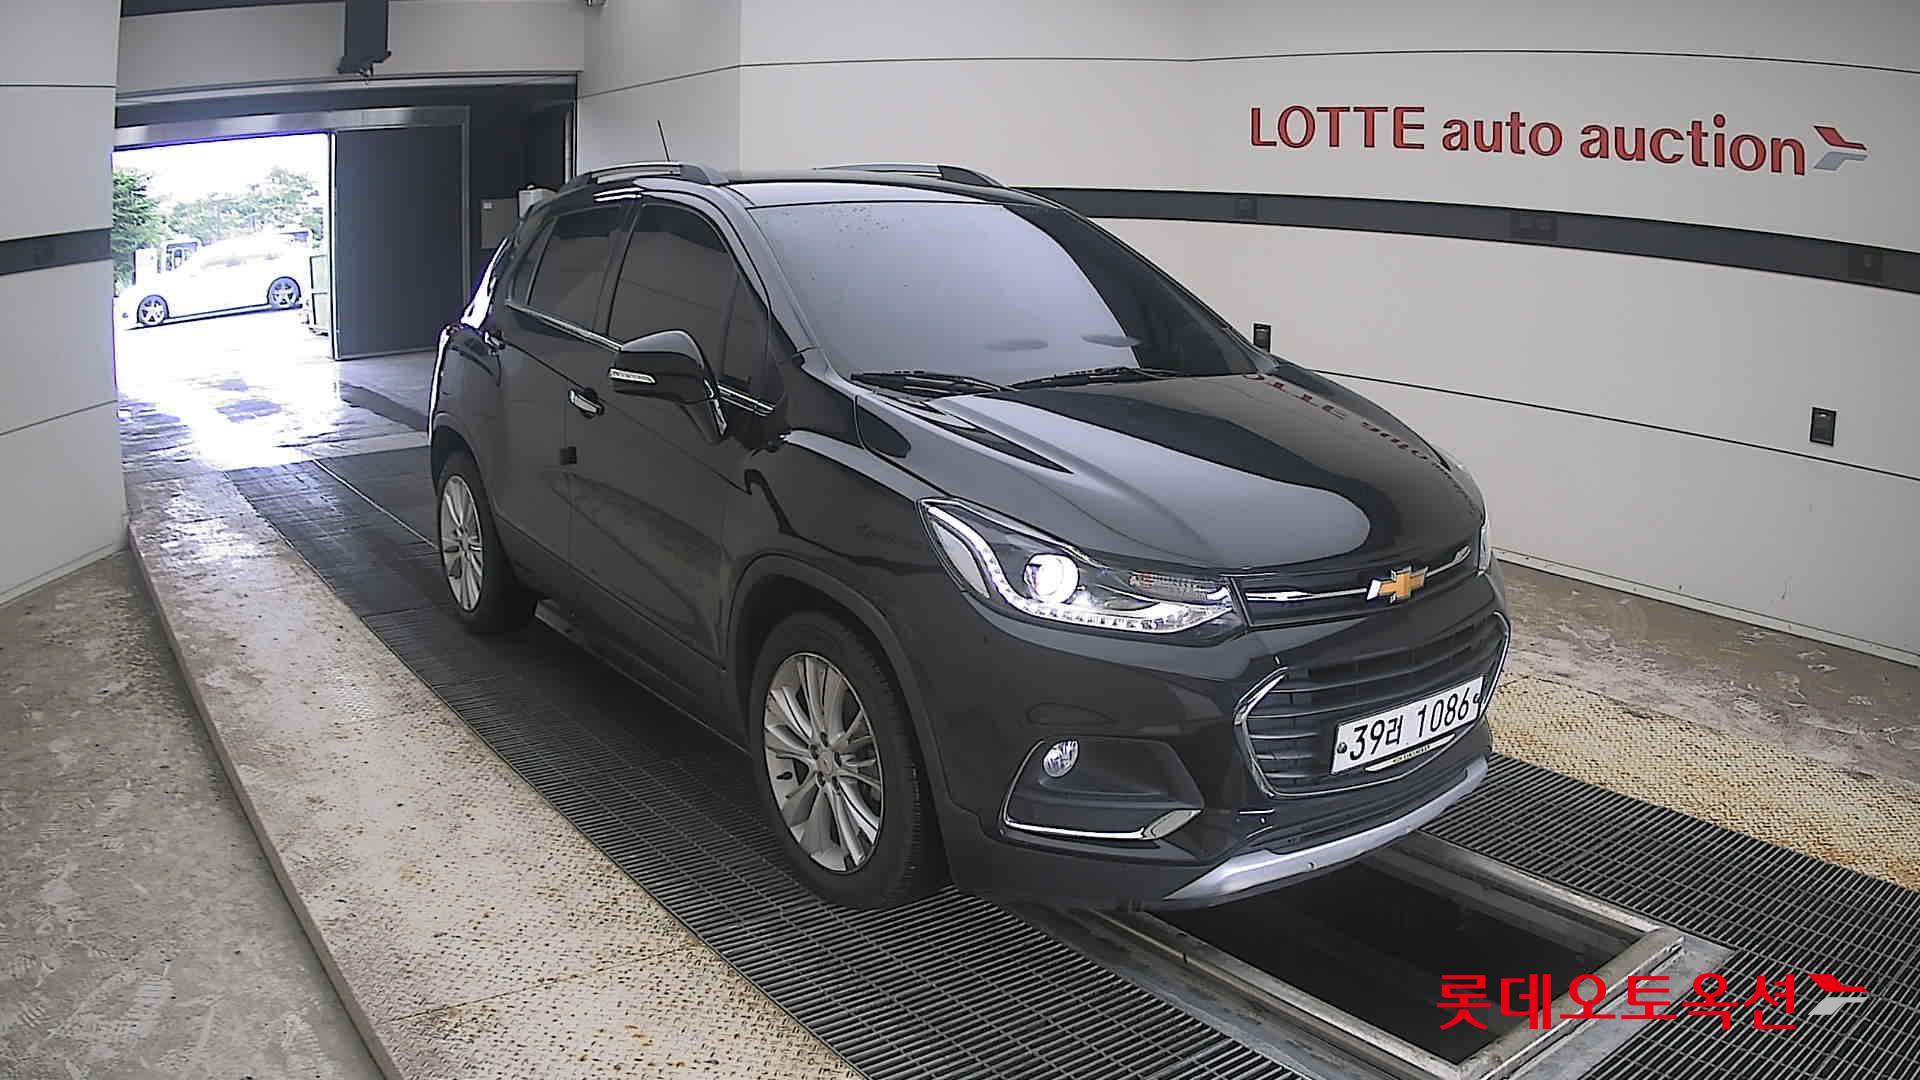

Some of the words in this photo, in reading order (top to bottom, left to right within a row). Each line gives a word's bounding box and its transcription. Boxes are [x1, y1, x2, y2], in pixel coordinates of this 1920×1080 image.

[1251, 105, 1425, 149] LOTTE
[1442, 112, 1562, 157] auto
[1580, 114, 1806, 176] auction
[1417, 687, 1470, 737] 1086
